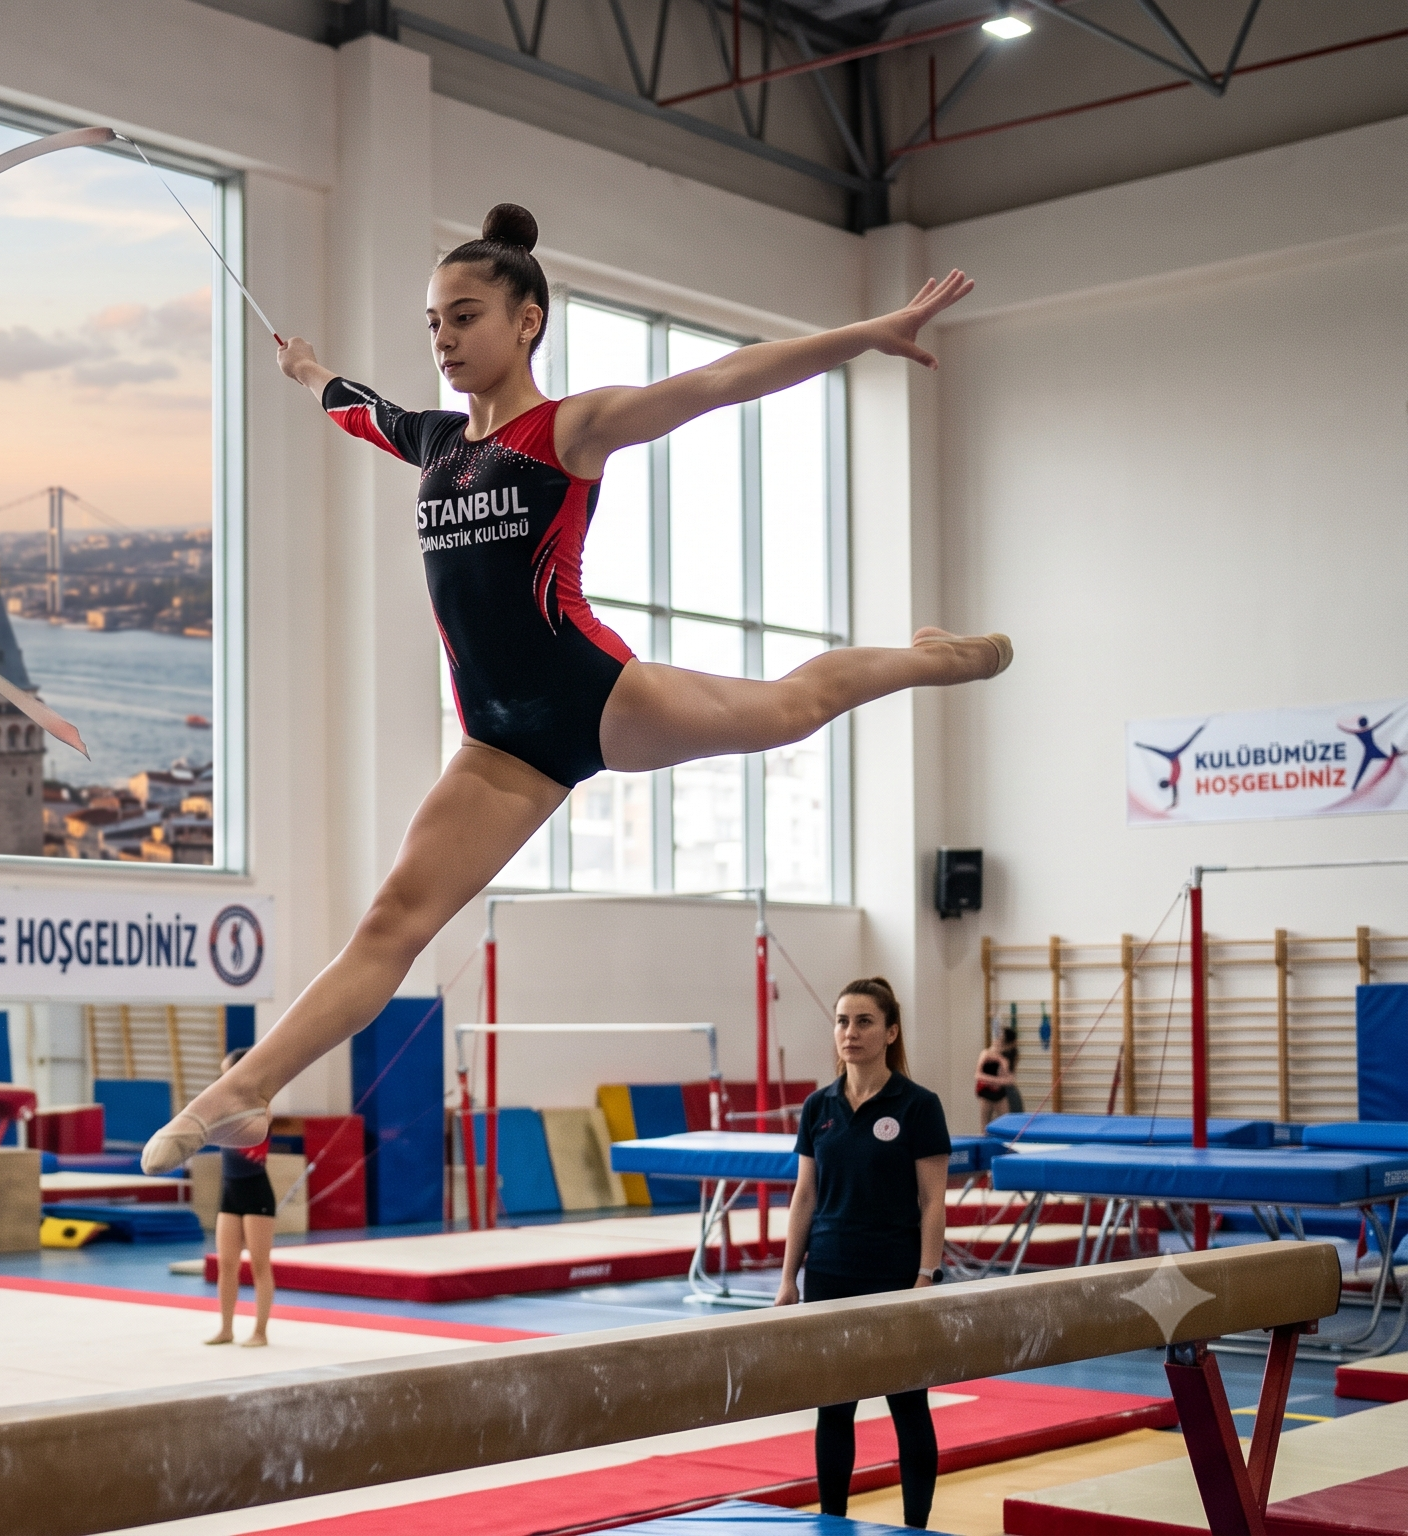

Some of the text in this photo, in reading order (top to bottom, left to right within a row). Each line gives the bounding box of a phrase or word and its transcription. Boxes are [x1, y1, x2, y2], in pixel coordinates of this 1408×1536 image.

[475, 518, 529, 544] KULÜBÜ
[1195, 740, 1347, 770] KULÜBÜMÜZE
[1195, 764, 1347, 797] HOŞGELDİNİZ
[17, 912, 198, 974] HOŞGELDİNİZ
